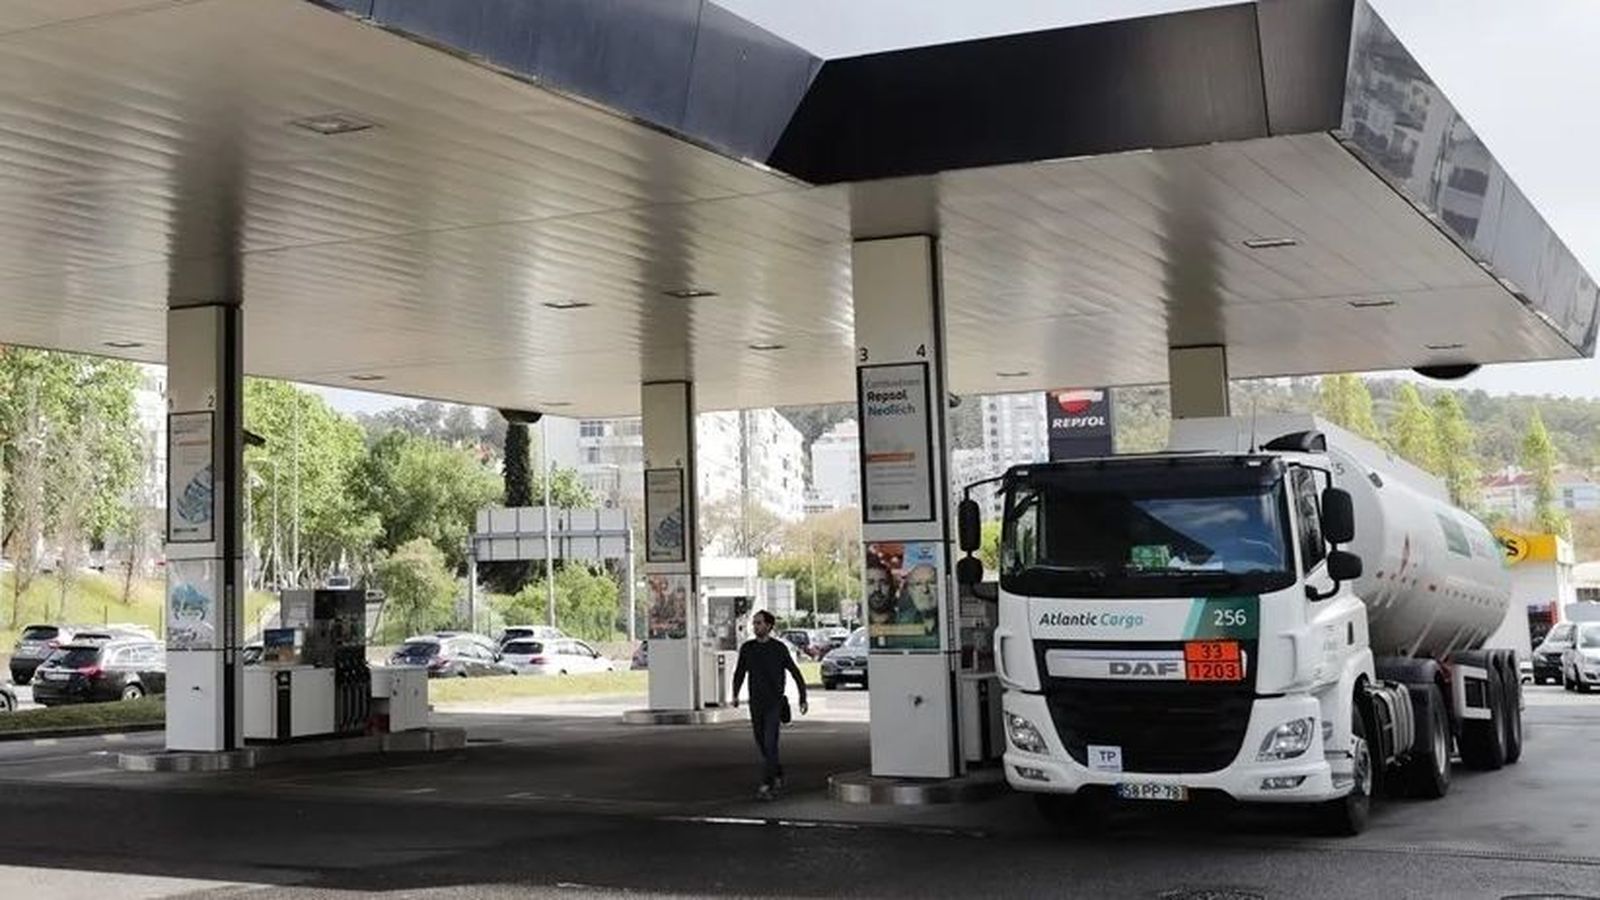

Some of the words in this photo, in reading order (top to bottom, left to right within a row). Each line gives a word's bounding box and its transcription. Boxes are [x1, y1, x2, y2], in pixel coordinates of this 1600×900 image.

[858, 347, 869, 362] 3
[916, 344, 926, 358] 4
[208, 395, 215, 407] 2
[867, 389, 908, 403] Repsol
[1052, 416, 1106, 429] REPSOL
[1039, 611, 1098, 627] Atlantic
[1100, 612, 1144, 629] Cargo
[1213, 609, 1247, 627] 256
[1201, 644, 1222, 659] 33
[1109, 661, 1180, 676] DAF
[1192, 664, 1236, 679] 1203
[1099, 751, 1117, 762] TP
